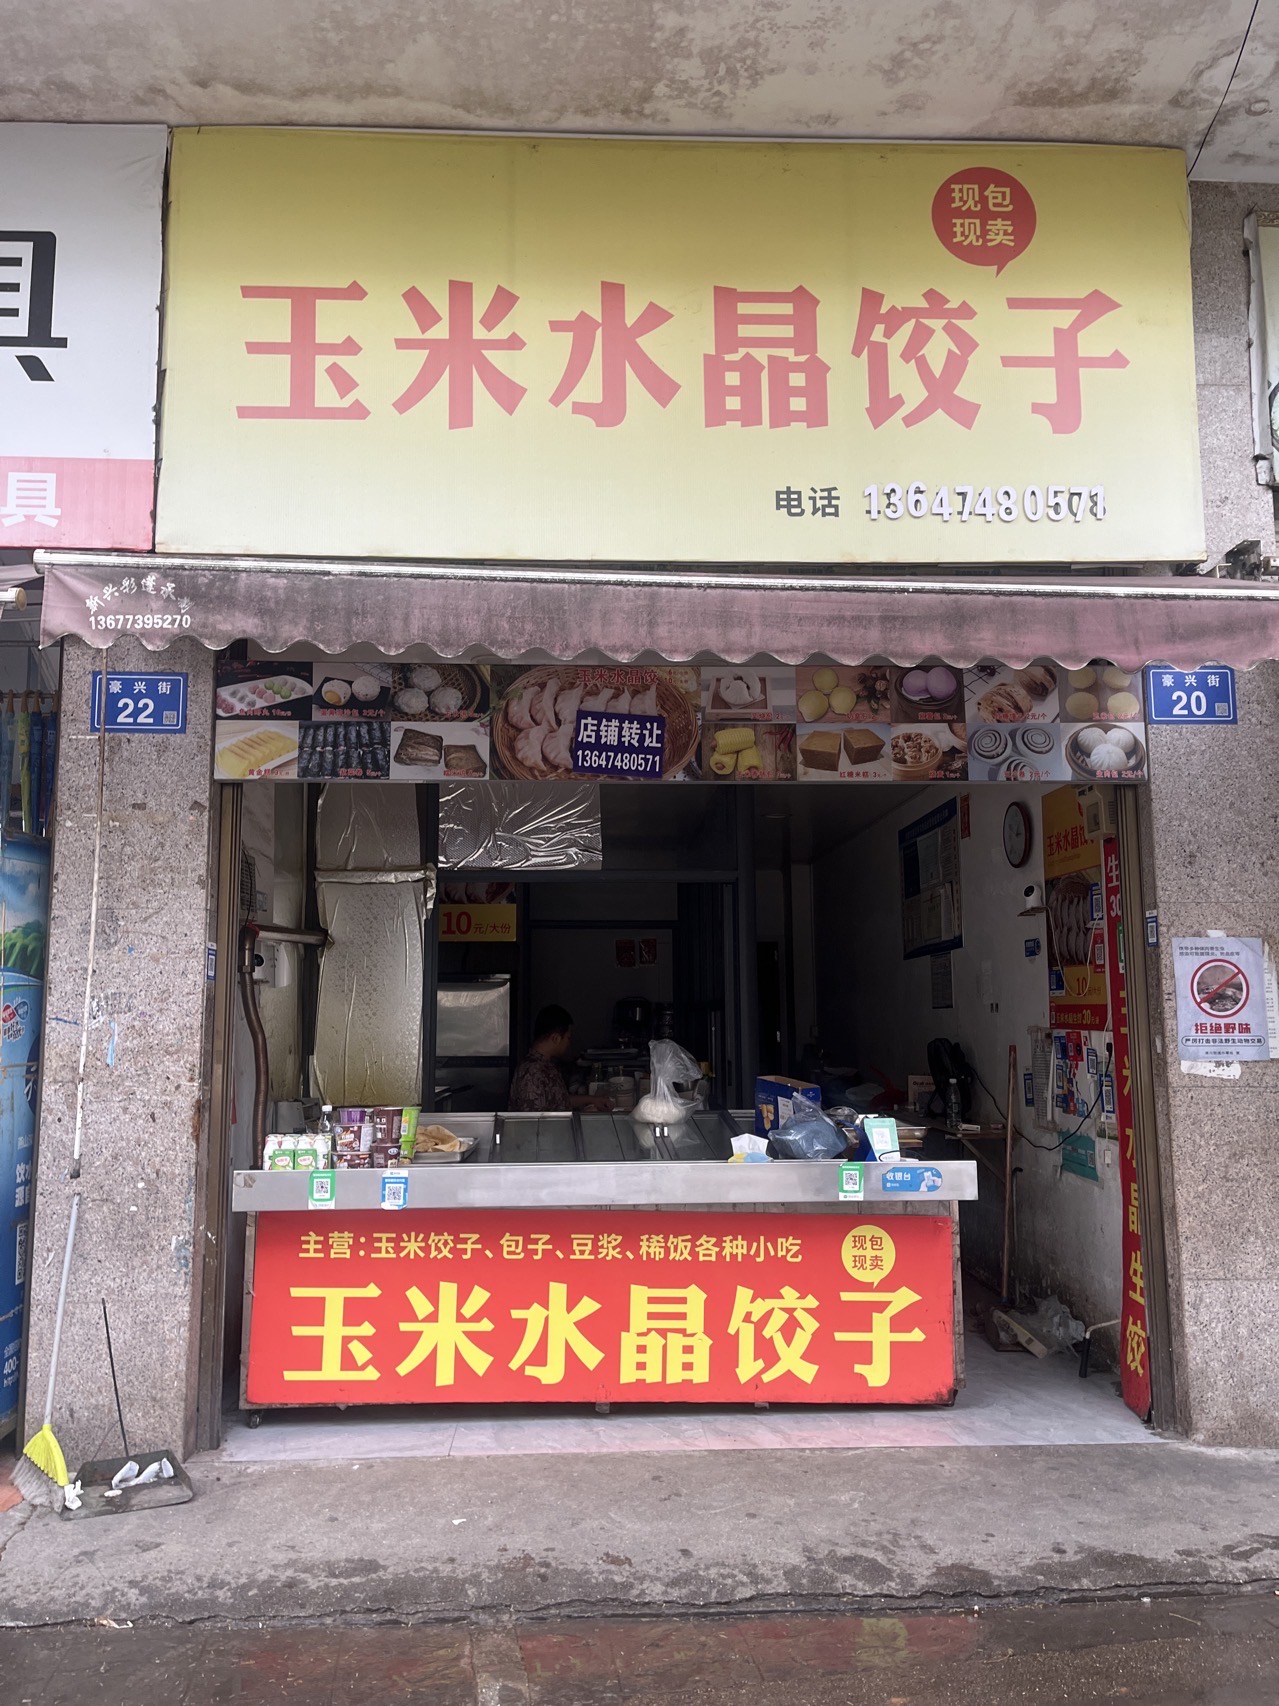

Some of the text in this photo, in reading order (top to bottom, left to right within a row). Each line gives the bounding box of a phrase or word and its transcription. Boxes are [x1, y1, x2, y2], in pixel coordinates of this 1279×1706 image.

[950, 183, 1014, 212] 现包
[951, 217, 1016, 248] 现卖
[235, 278, 1132, 436] 玉米水晶饺子
[775, 481, 1107, 523] 电话 13647480571
[89, 614, 192, 631] 13677395270
[577, 668, 658, 685] 玉米水晶饺
[1161, 673, 1220, 688] 豪兴街
[108, 679, 172, 695] 豪兴街
[116, 697, 155, 724] 22
[1171, 690, 1208, 716] 20
[1025, 712, 1048, 721] 2元/个
[577, 716, 663, 748] 店铺转让
[576, 749, 661, 773] 13647480571
[839, 770, 870, 779] 红糖米糕
[441, 909, 512, 936] 10元/大份
[1194, 1022, 1252, 1035] 拒绝野味
[1184, 1037, 1263, 1046] 严厉打击非法野生动物交易
[886, 1171, 911, 1181] 收银台
[850, 1233, 885, 1252] 现包
[851, 1253, 885, 1273] 现卖
[282, 1280, 927, 1388] 玉米水晶饺子
